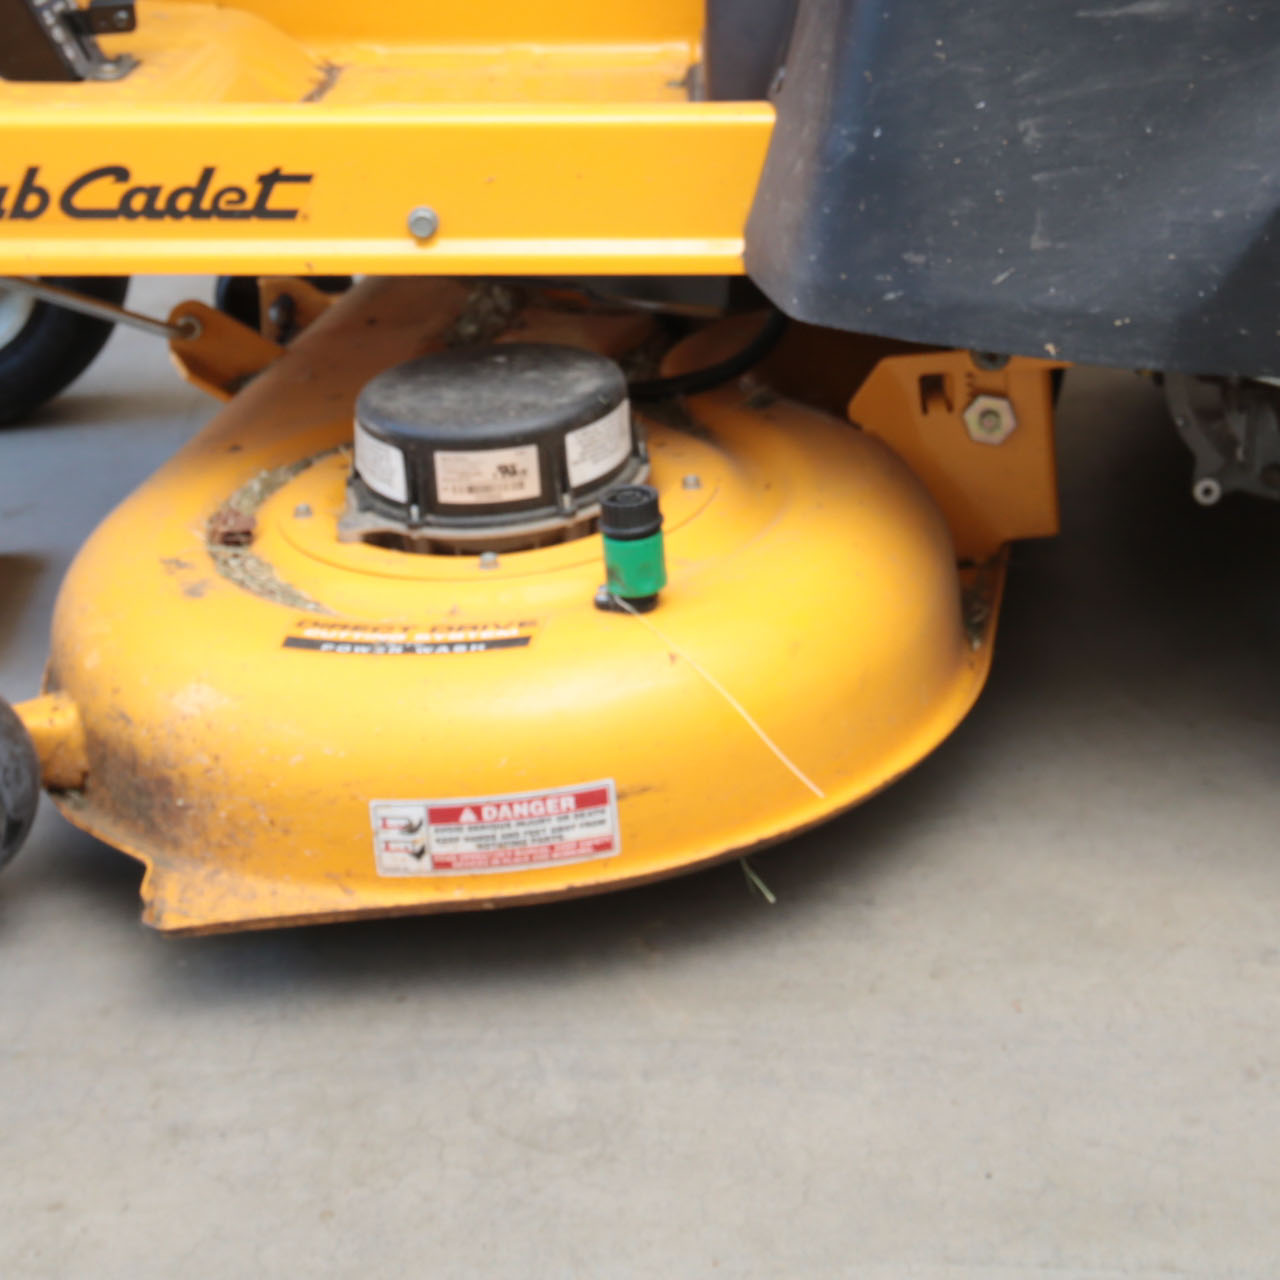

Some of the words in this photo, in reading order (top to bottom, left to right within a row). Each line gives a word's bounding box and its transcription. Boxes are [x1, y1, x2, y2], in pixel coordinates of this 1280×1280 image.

[60, 166, 314, 221] Cadet
[430, 619, 537, 633] DRIVE
[481, 796, 577, 821] DANGER
